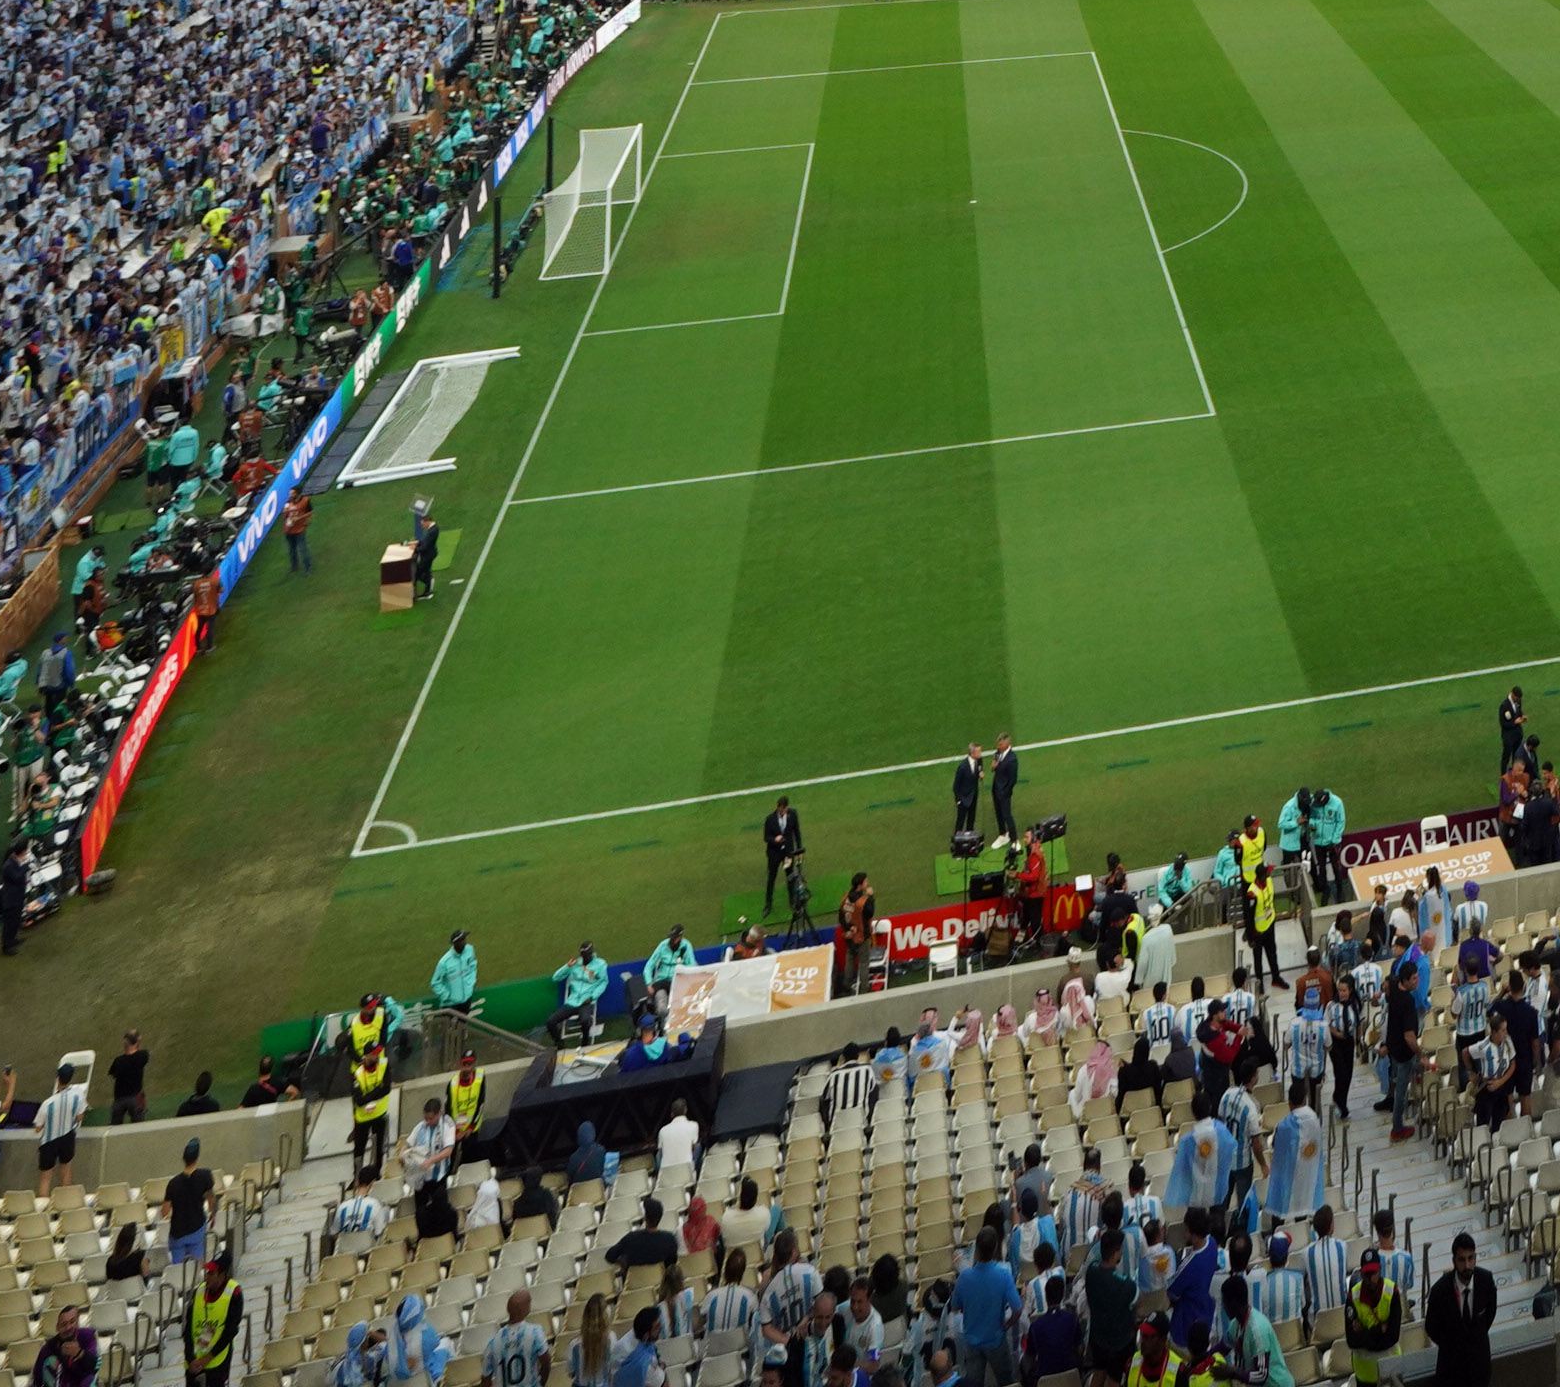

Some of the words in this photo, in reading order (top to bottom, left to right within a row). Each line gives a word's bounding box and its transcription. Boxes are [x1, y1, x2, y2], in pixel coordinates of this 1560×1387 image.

[293, 416, 328, 480] vivo
[237, 490, 279, 564] vivo
[1368, 871, 1403, 887] FIFA
[1463, 851, 1493, 867] CUP
[894, 920, 940, 954] We
[786, 966, 820, 981] CUP
[1469, 1000, 1484, 1019] 10
[1151, 1016, 1169, 1042] 10
[498, 1353, 526, 1387] 10
